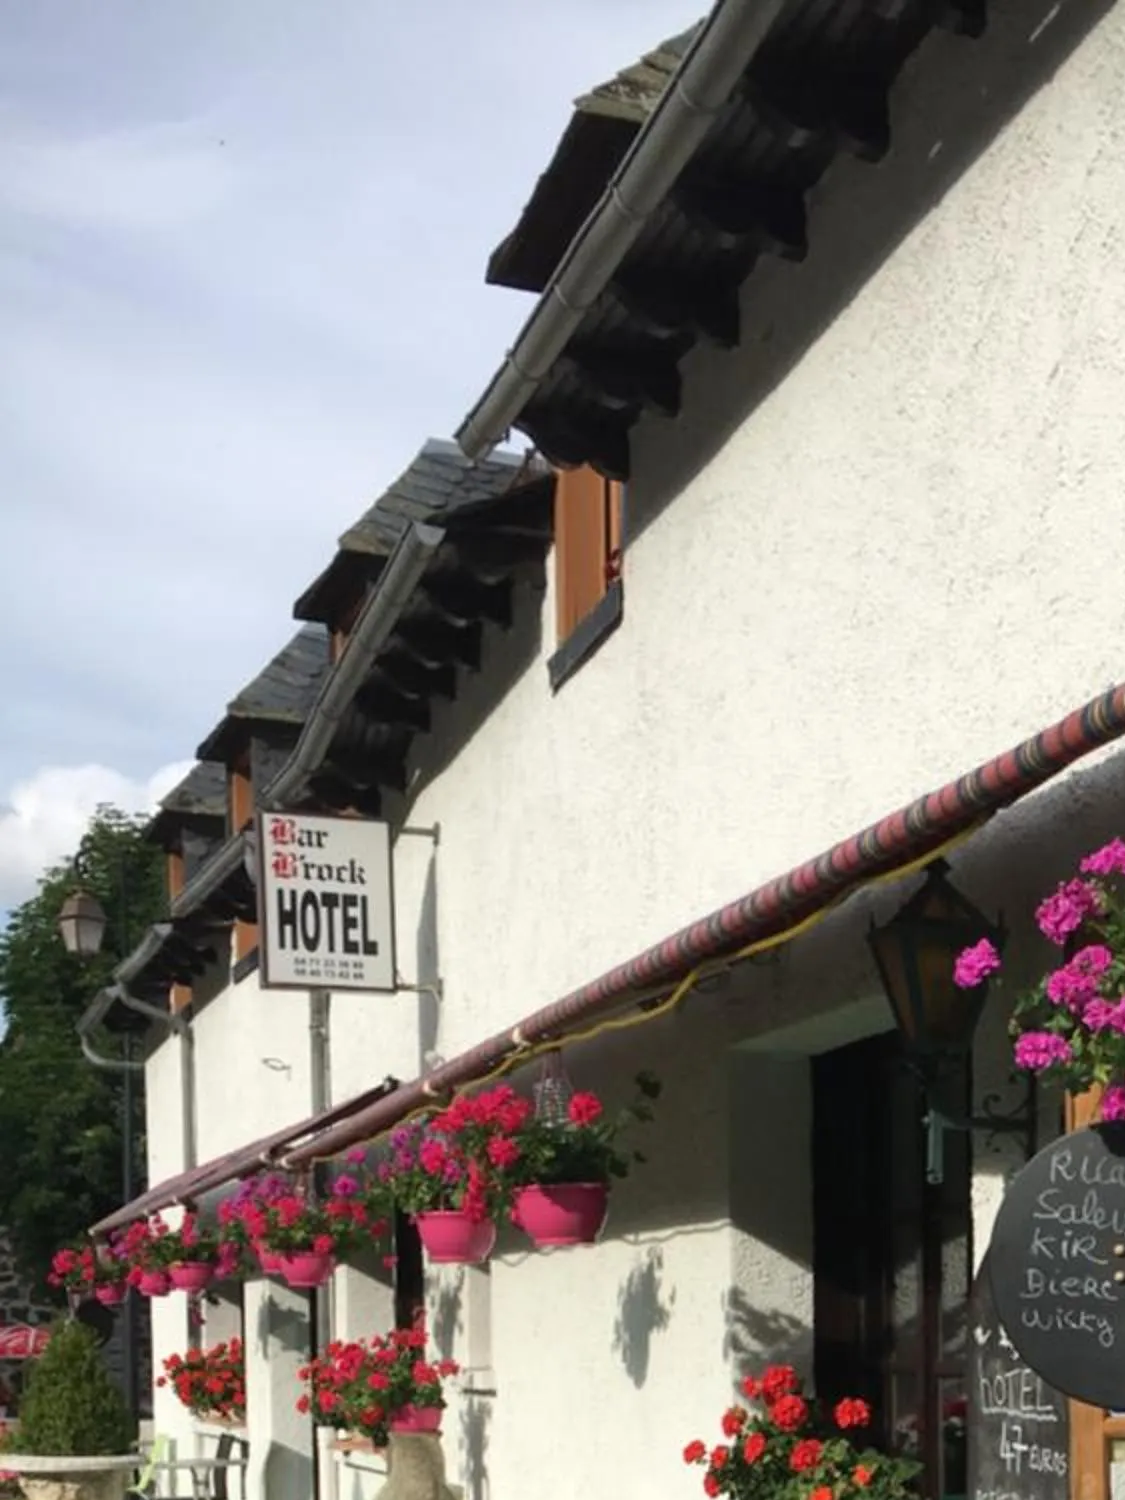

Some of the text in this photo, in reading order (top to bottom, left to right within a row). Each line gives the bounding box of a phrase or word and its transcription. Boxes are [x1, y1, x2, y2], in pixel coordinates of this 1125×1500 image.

[271, 817, 329, 848] Bar
[277, 888, 379, 956] HOTEL
[1000, 1421, 1028, 1475] 47
